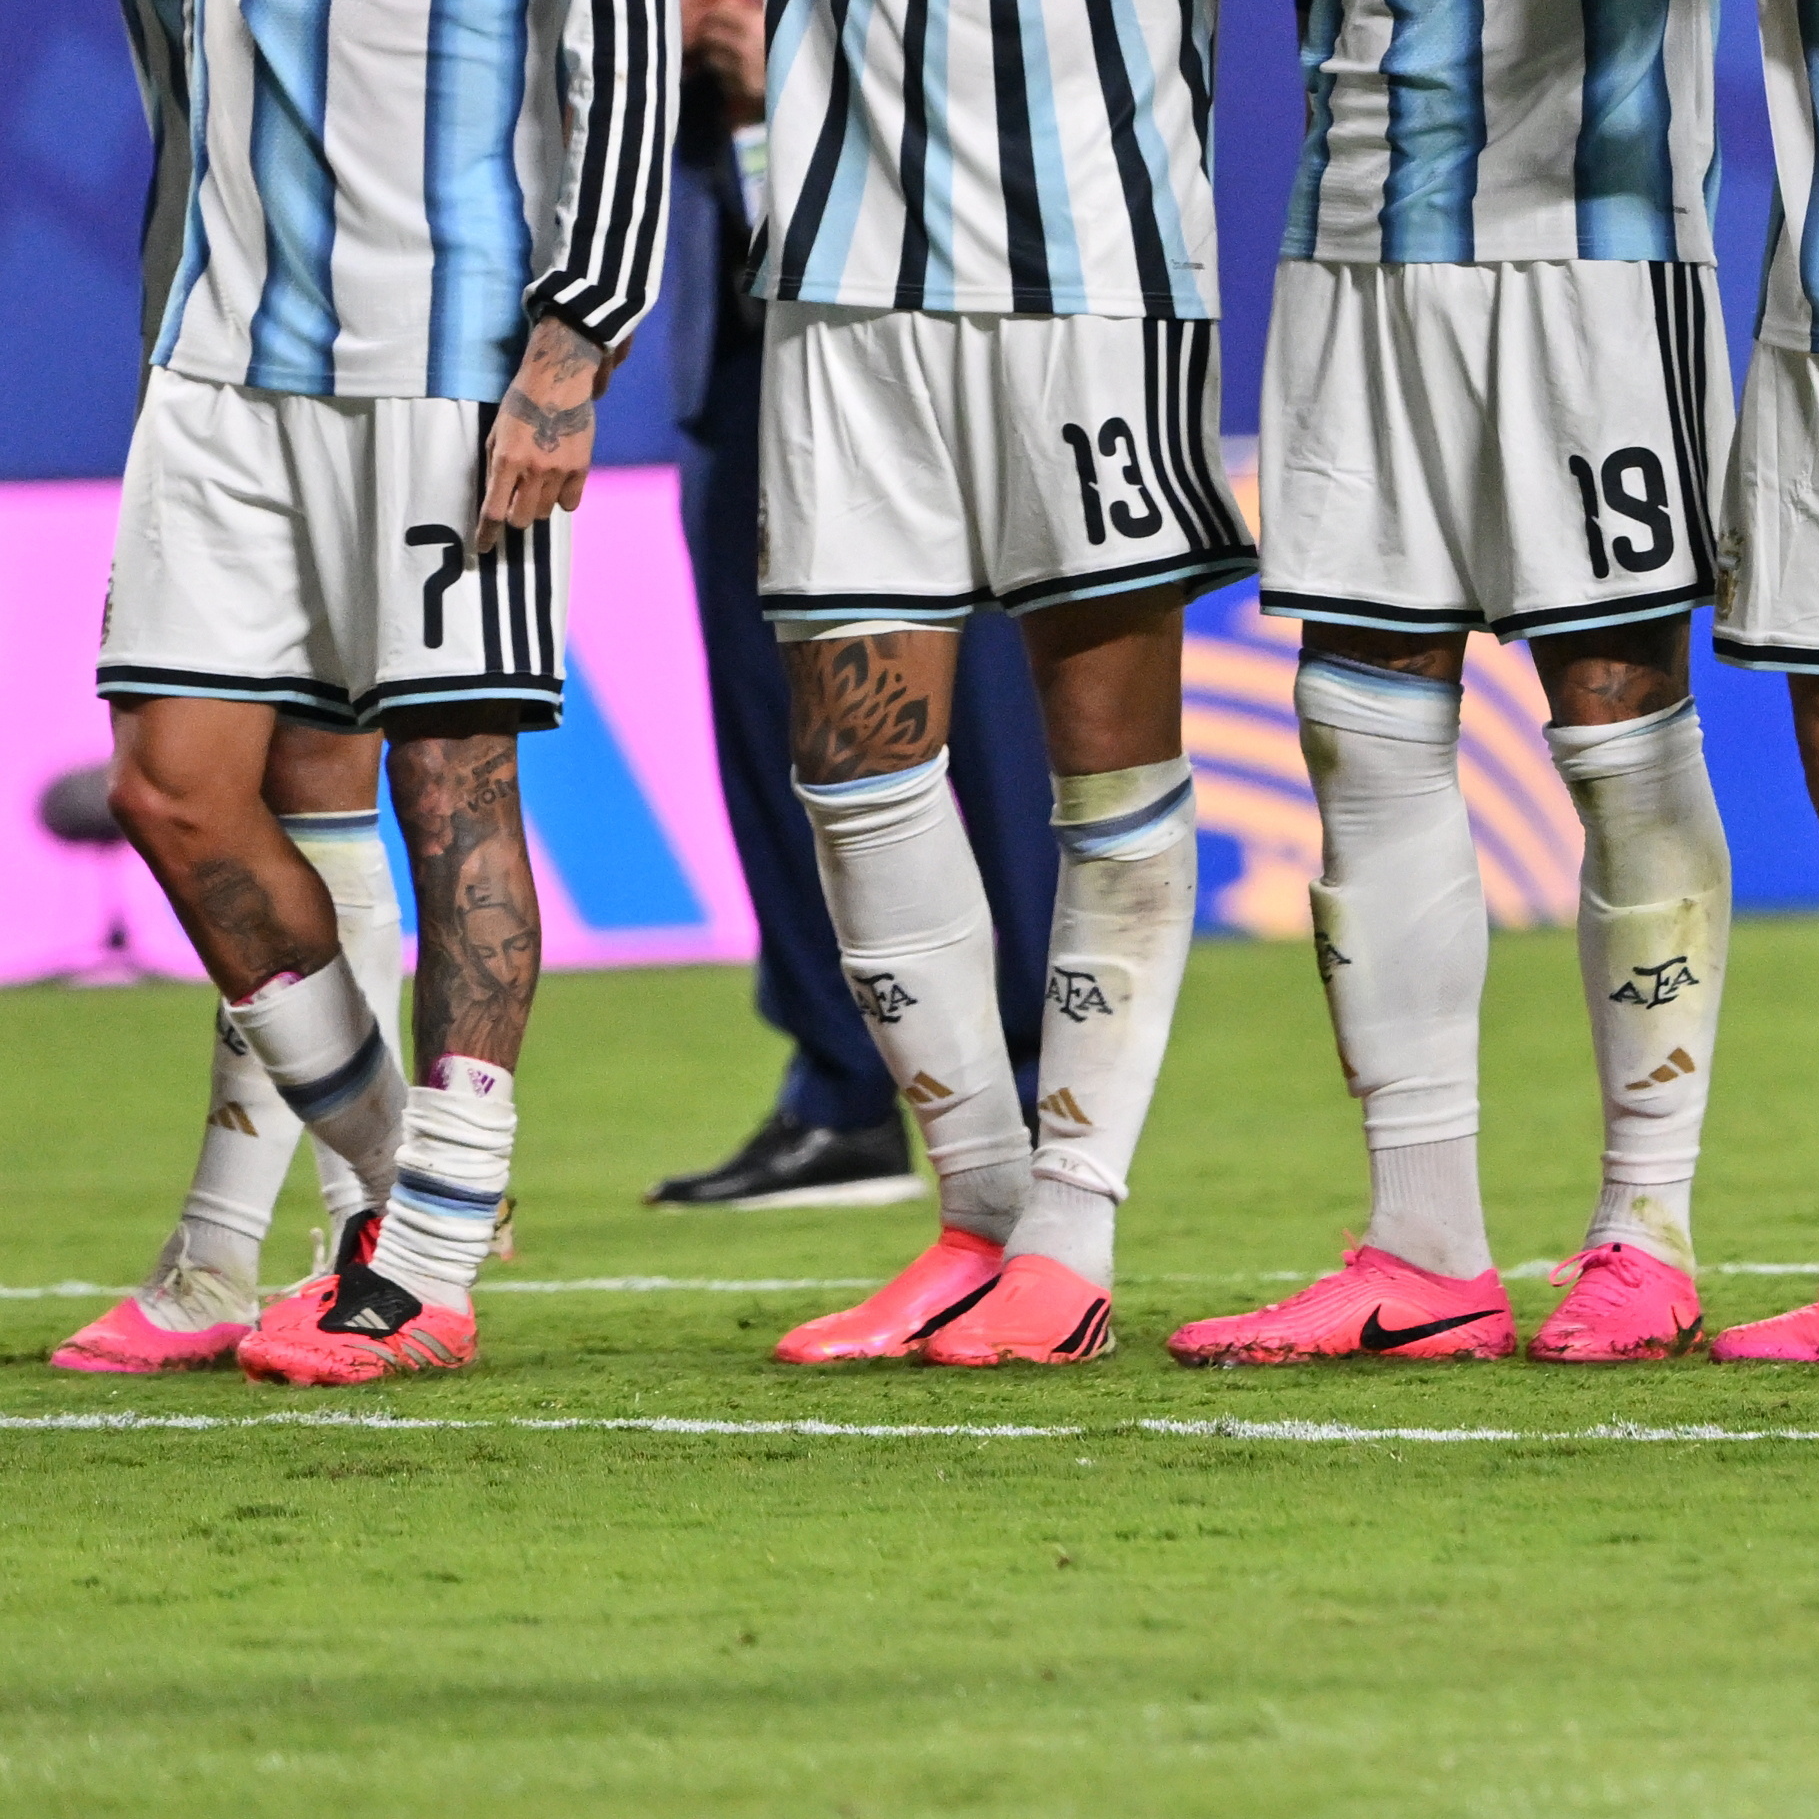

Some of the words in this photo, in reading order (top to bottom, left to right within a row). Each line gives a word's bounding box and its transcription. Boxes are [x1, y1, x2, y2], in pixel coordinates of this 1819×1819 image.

[1062, 417, 1165, 545] 13
[1568, 447, 1674, 579] 19
[405, 524, 464, 649] 7
[1046, 966, 1113, 1022] AFA
[1609, 956, 1699, 1010] AFA
